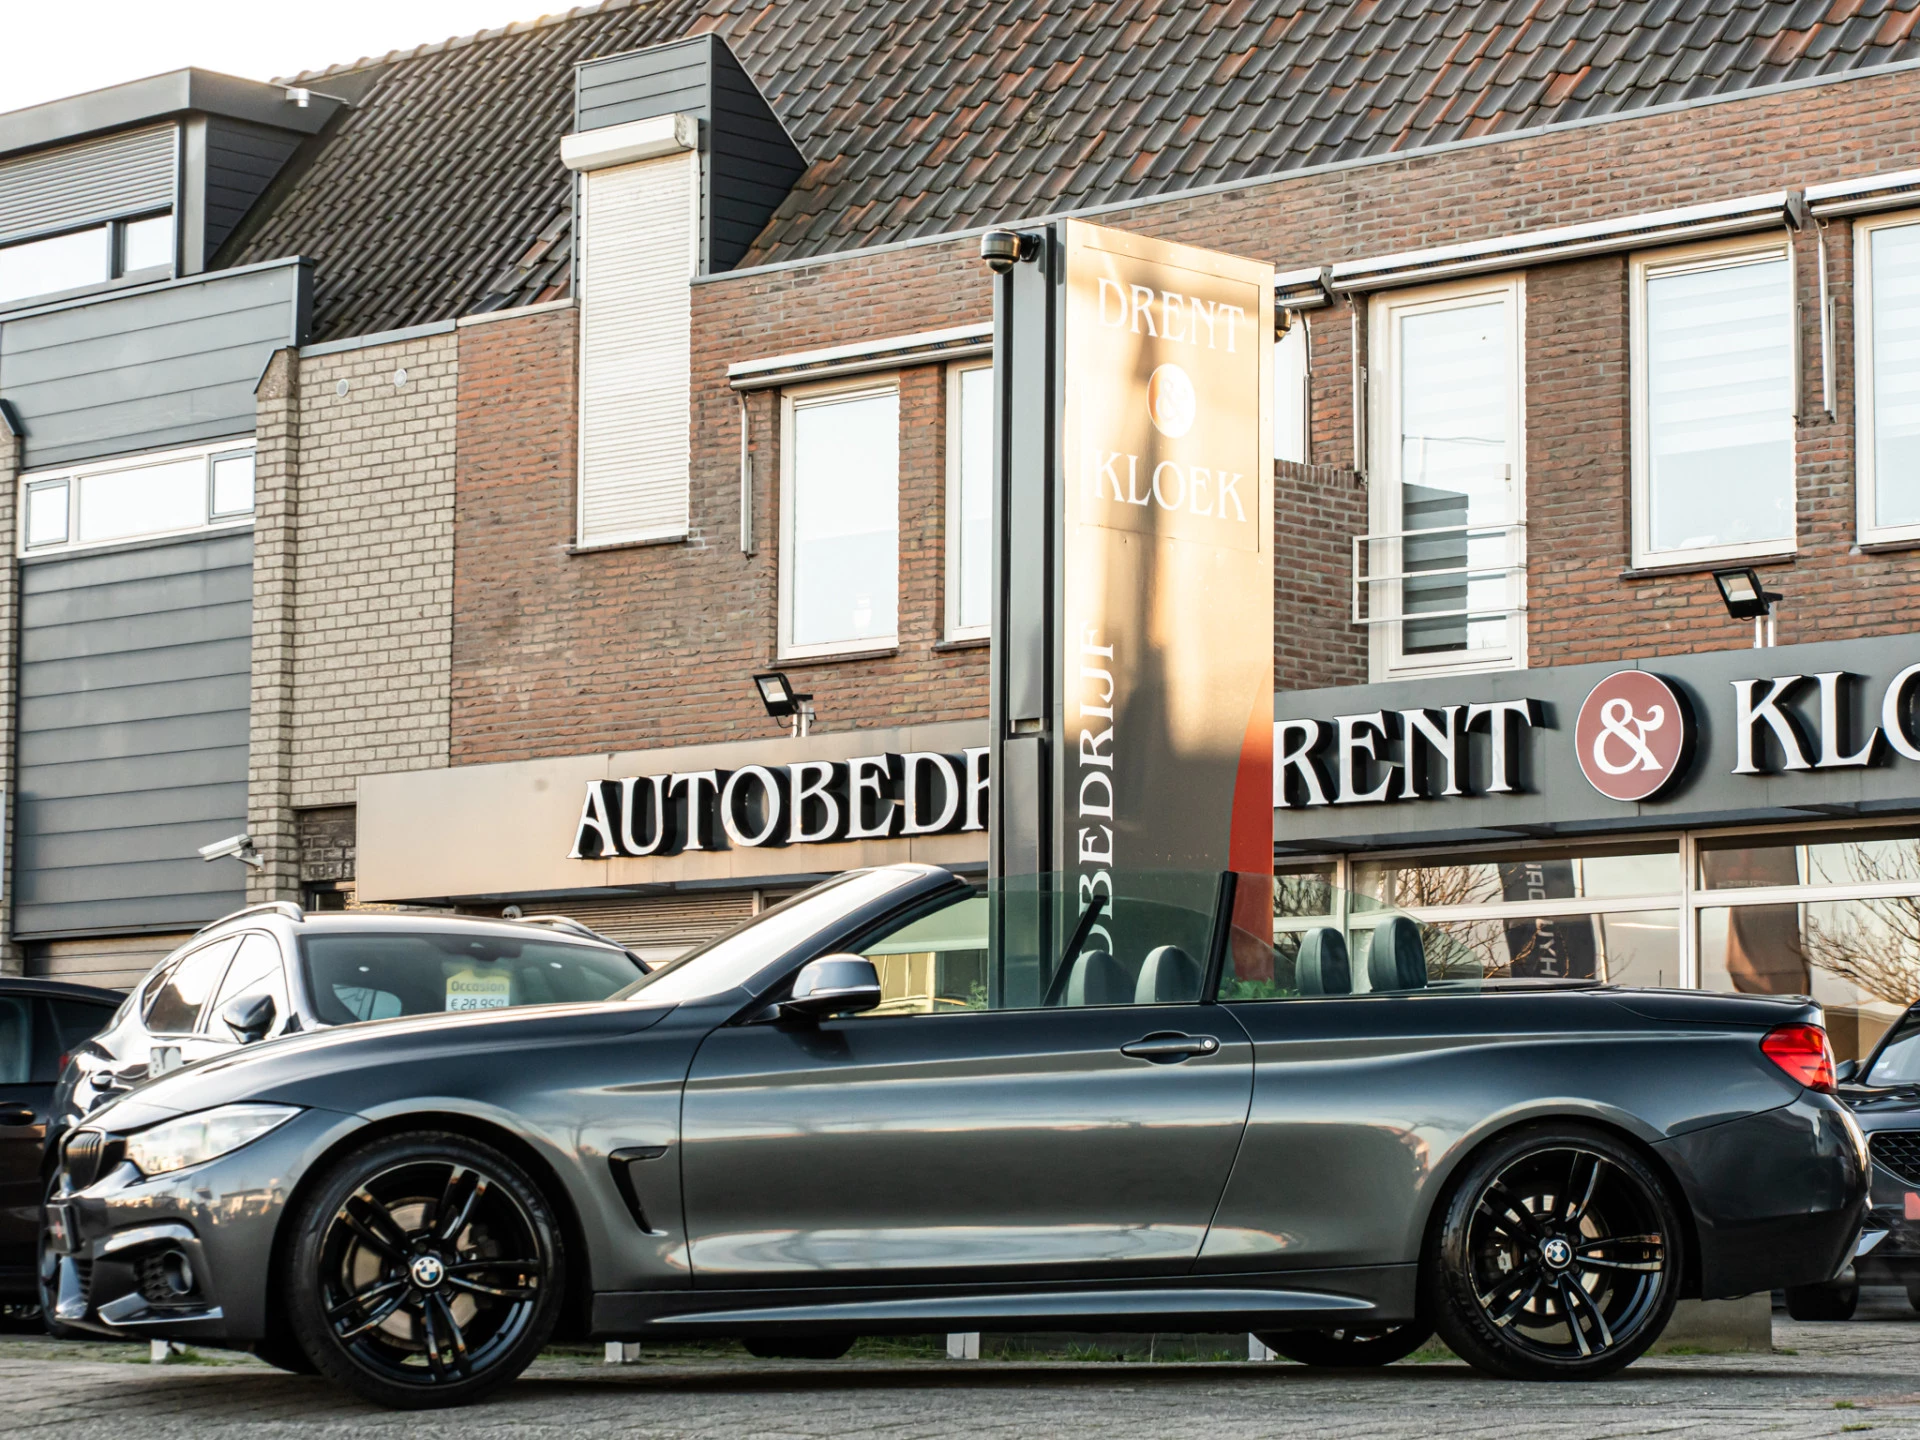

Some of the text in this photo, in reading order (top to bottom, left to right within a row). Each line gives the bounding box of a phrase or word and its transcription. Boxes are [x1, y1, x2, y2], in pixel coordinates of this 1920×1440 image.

[1097, 277, 1248, 353] DRENT
[1095, 451, 1247, 522] KLOEK
[1593, 697, 1664, 774] &
[451, 981, 505, 992] Occasion
